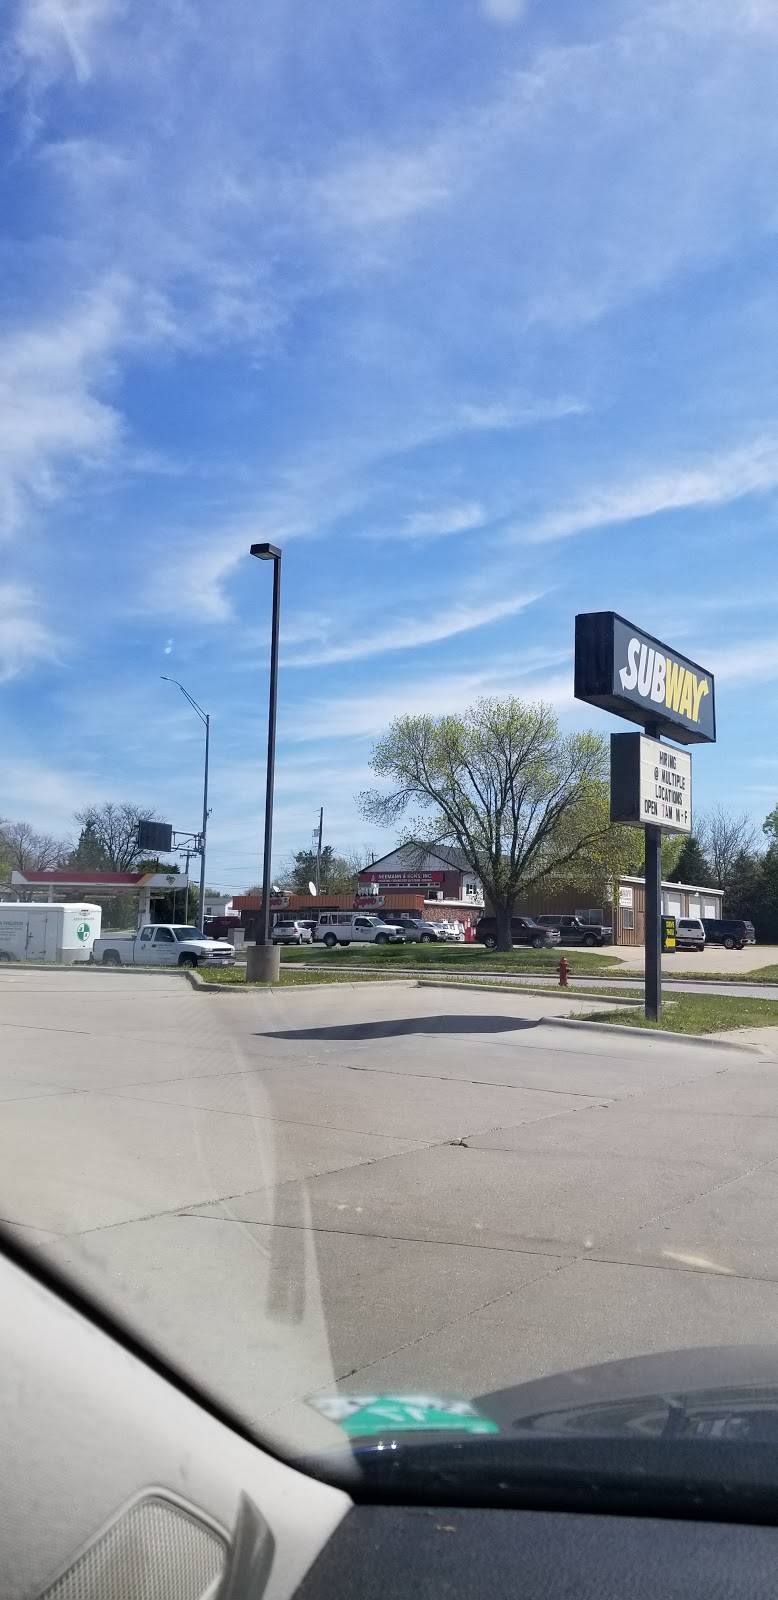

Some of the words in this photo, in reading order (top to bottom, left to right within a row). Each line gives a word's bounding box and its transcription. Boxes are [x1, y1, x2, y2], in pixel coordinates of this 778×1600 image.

[619, 638, 709, 722] SUBWAY
[659, 750, 677, 770] HIRING
[661, 769, 686, 790] MULTIPLE
[655, 784, 683, 805] LOCATIONS
[644, 799, 658, 816] OPEN
